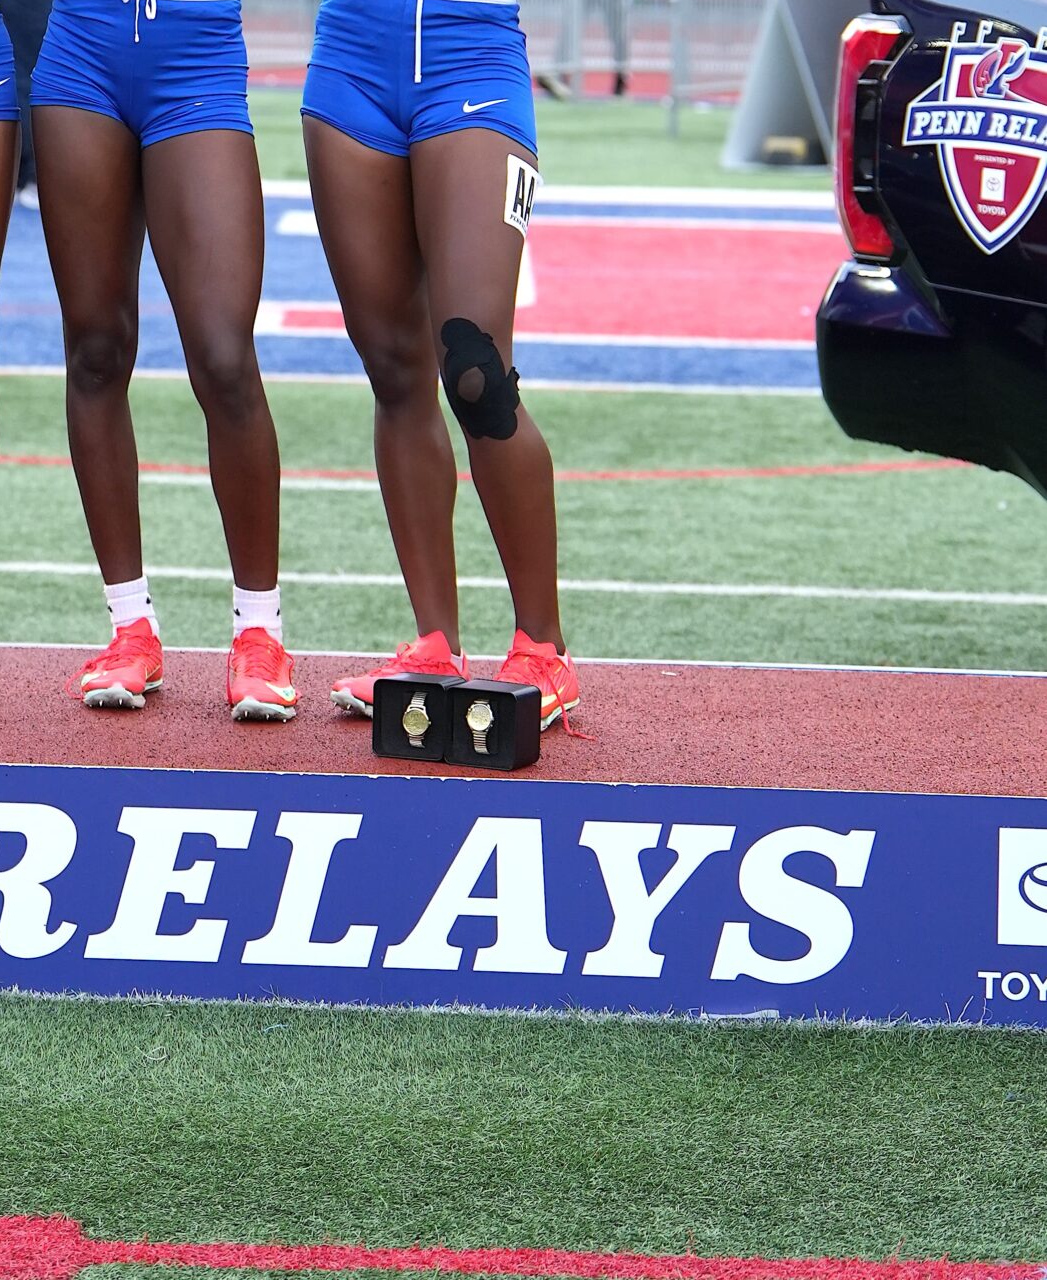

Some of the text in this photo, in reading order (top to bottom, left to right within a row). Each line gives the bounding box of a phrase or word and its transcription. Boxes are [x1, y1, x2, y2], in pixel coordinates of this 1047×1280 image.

[912, 110, 986, 137] PENN
[977, 204, 1007, 217] TOYOTA
[977, 971, 1047, 1001] TOY
